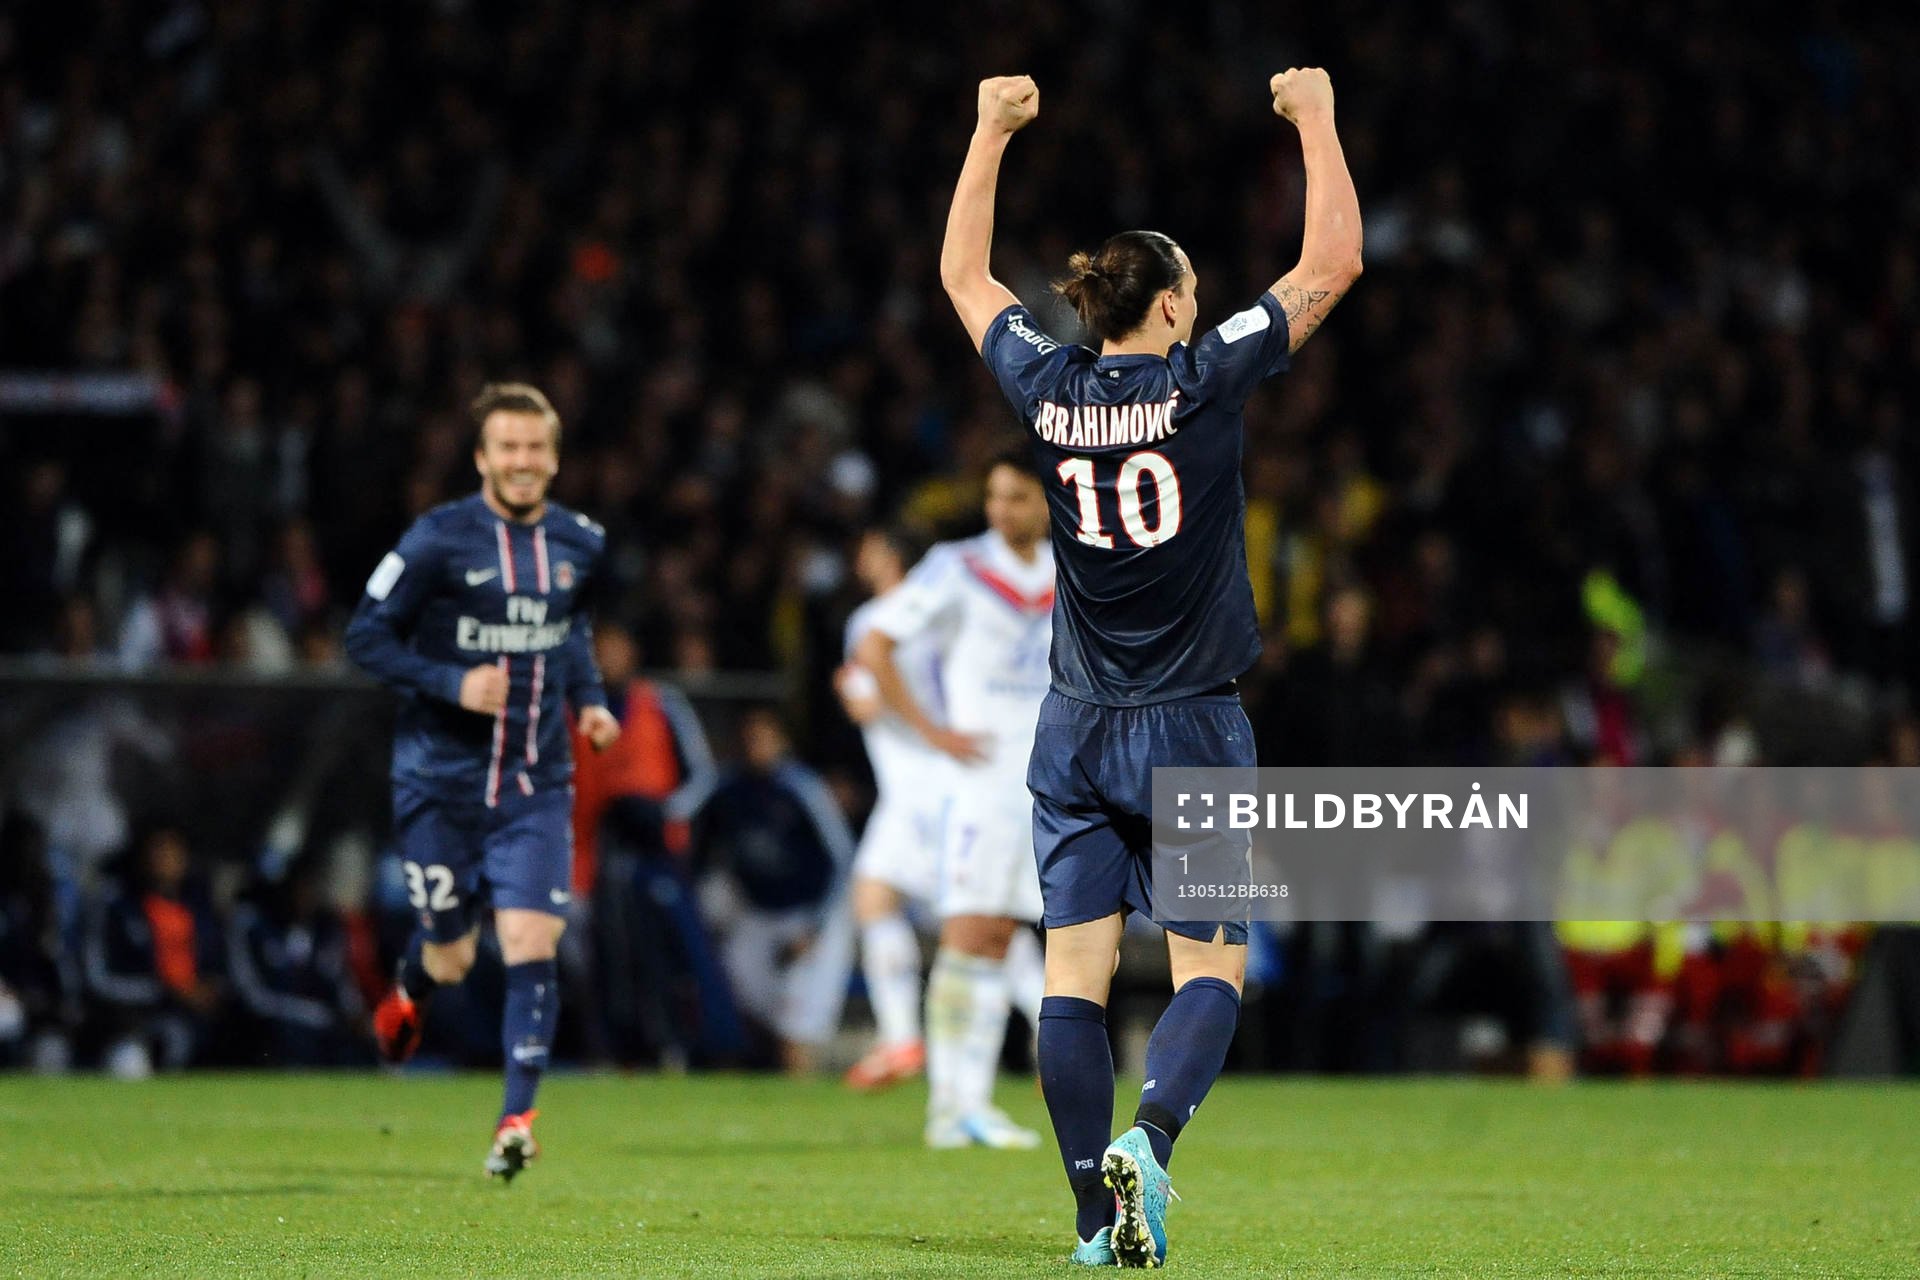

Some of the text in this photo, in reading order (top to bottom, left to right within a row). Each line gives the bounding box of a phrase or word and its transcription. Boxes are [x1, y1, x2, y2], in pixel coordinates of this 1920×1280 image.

[1057, 451, 1183, 550] 10
[404, 860, 460, 911] 32
[1075, 1158, 1094, 1170] PSG
